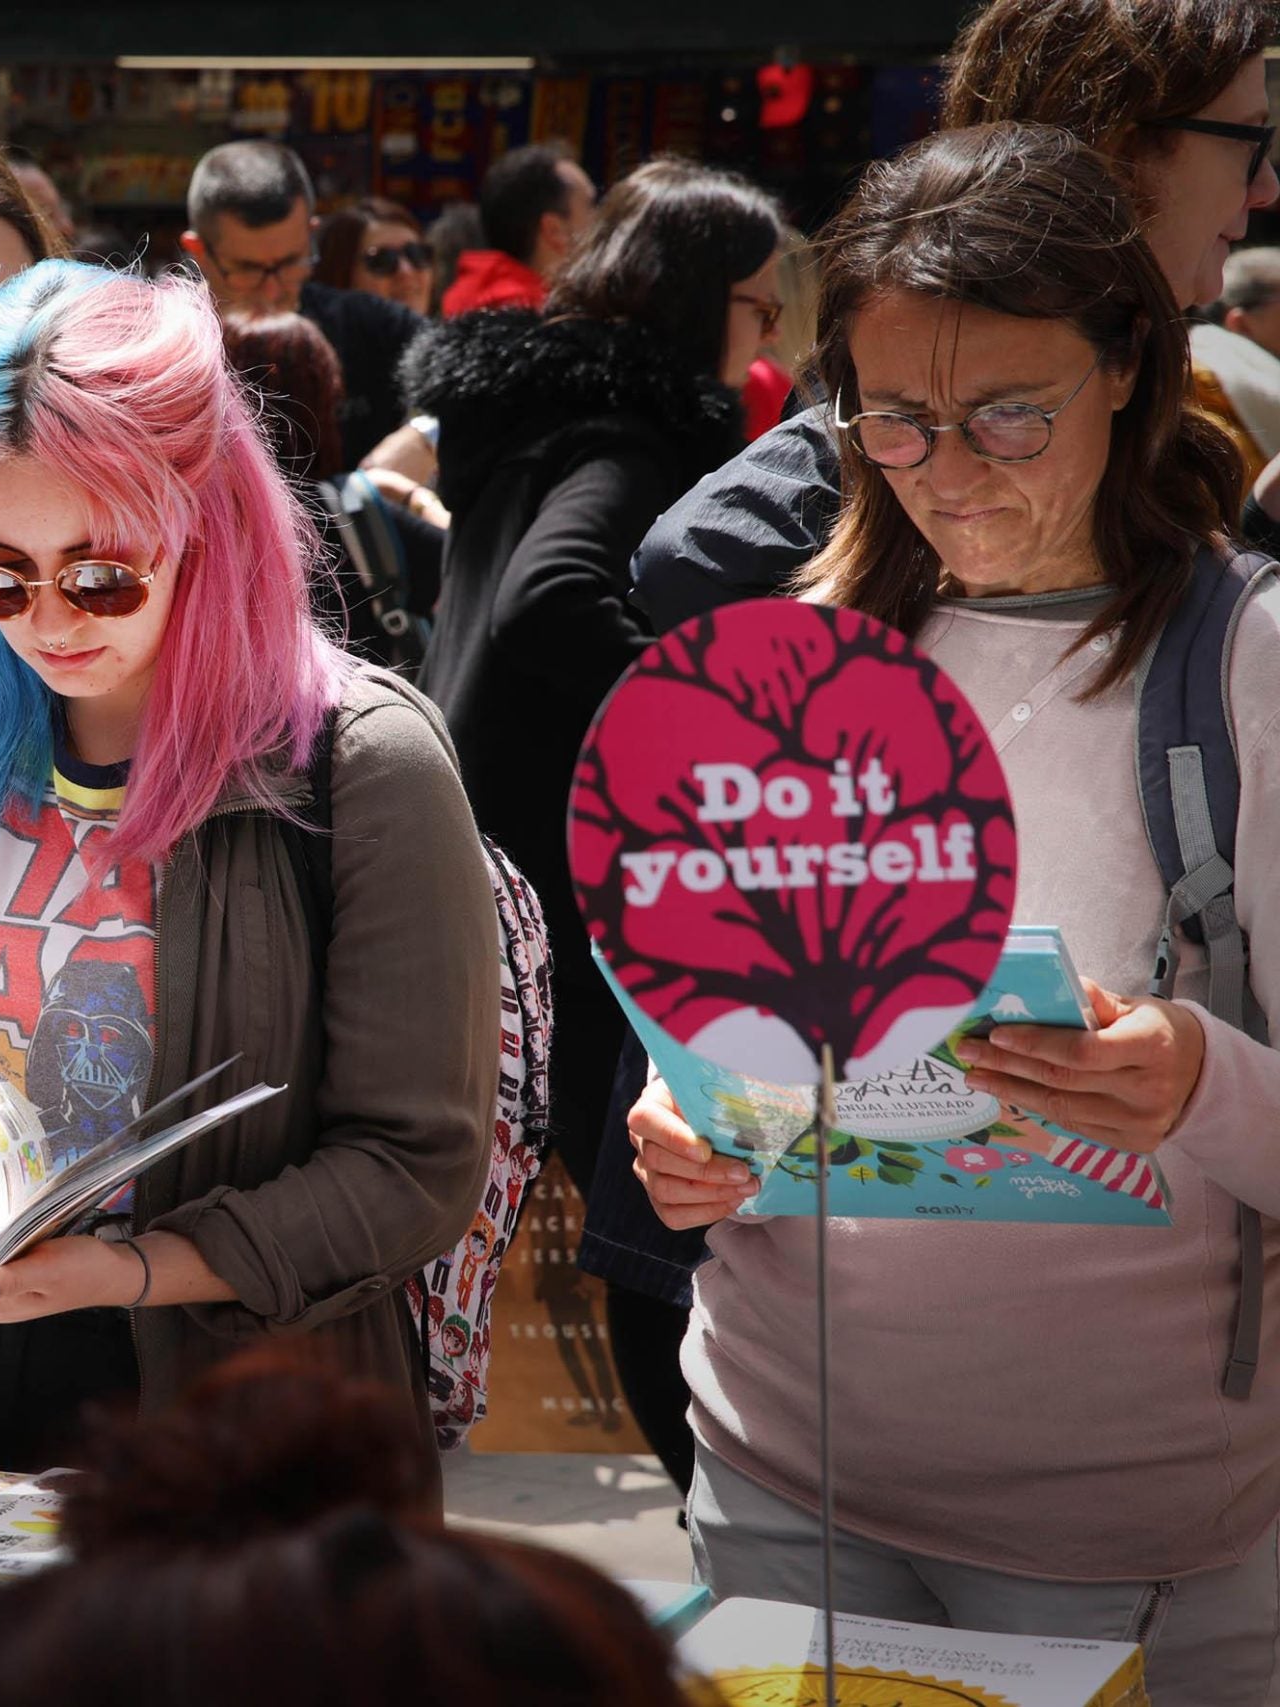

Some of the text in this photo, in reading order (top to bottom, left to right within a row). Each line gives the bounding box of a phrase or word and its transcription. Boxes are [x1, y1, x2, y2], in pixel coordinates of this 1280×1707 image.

[692, 757, 897, 823] Do it
[620, 824, 978, 908] yourself
[836, 1102, 888, 1113] ANUAL
